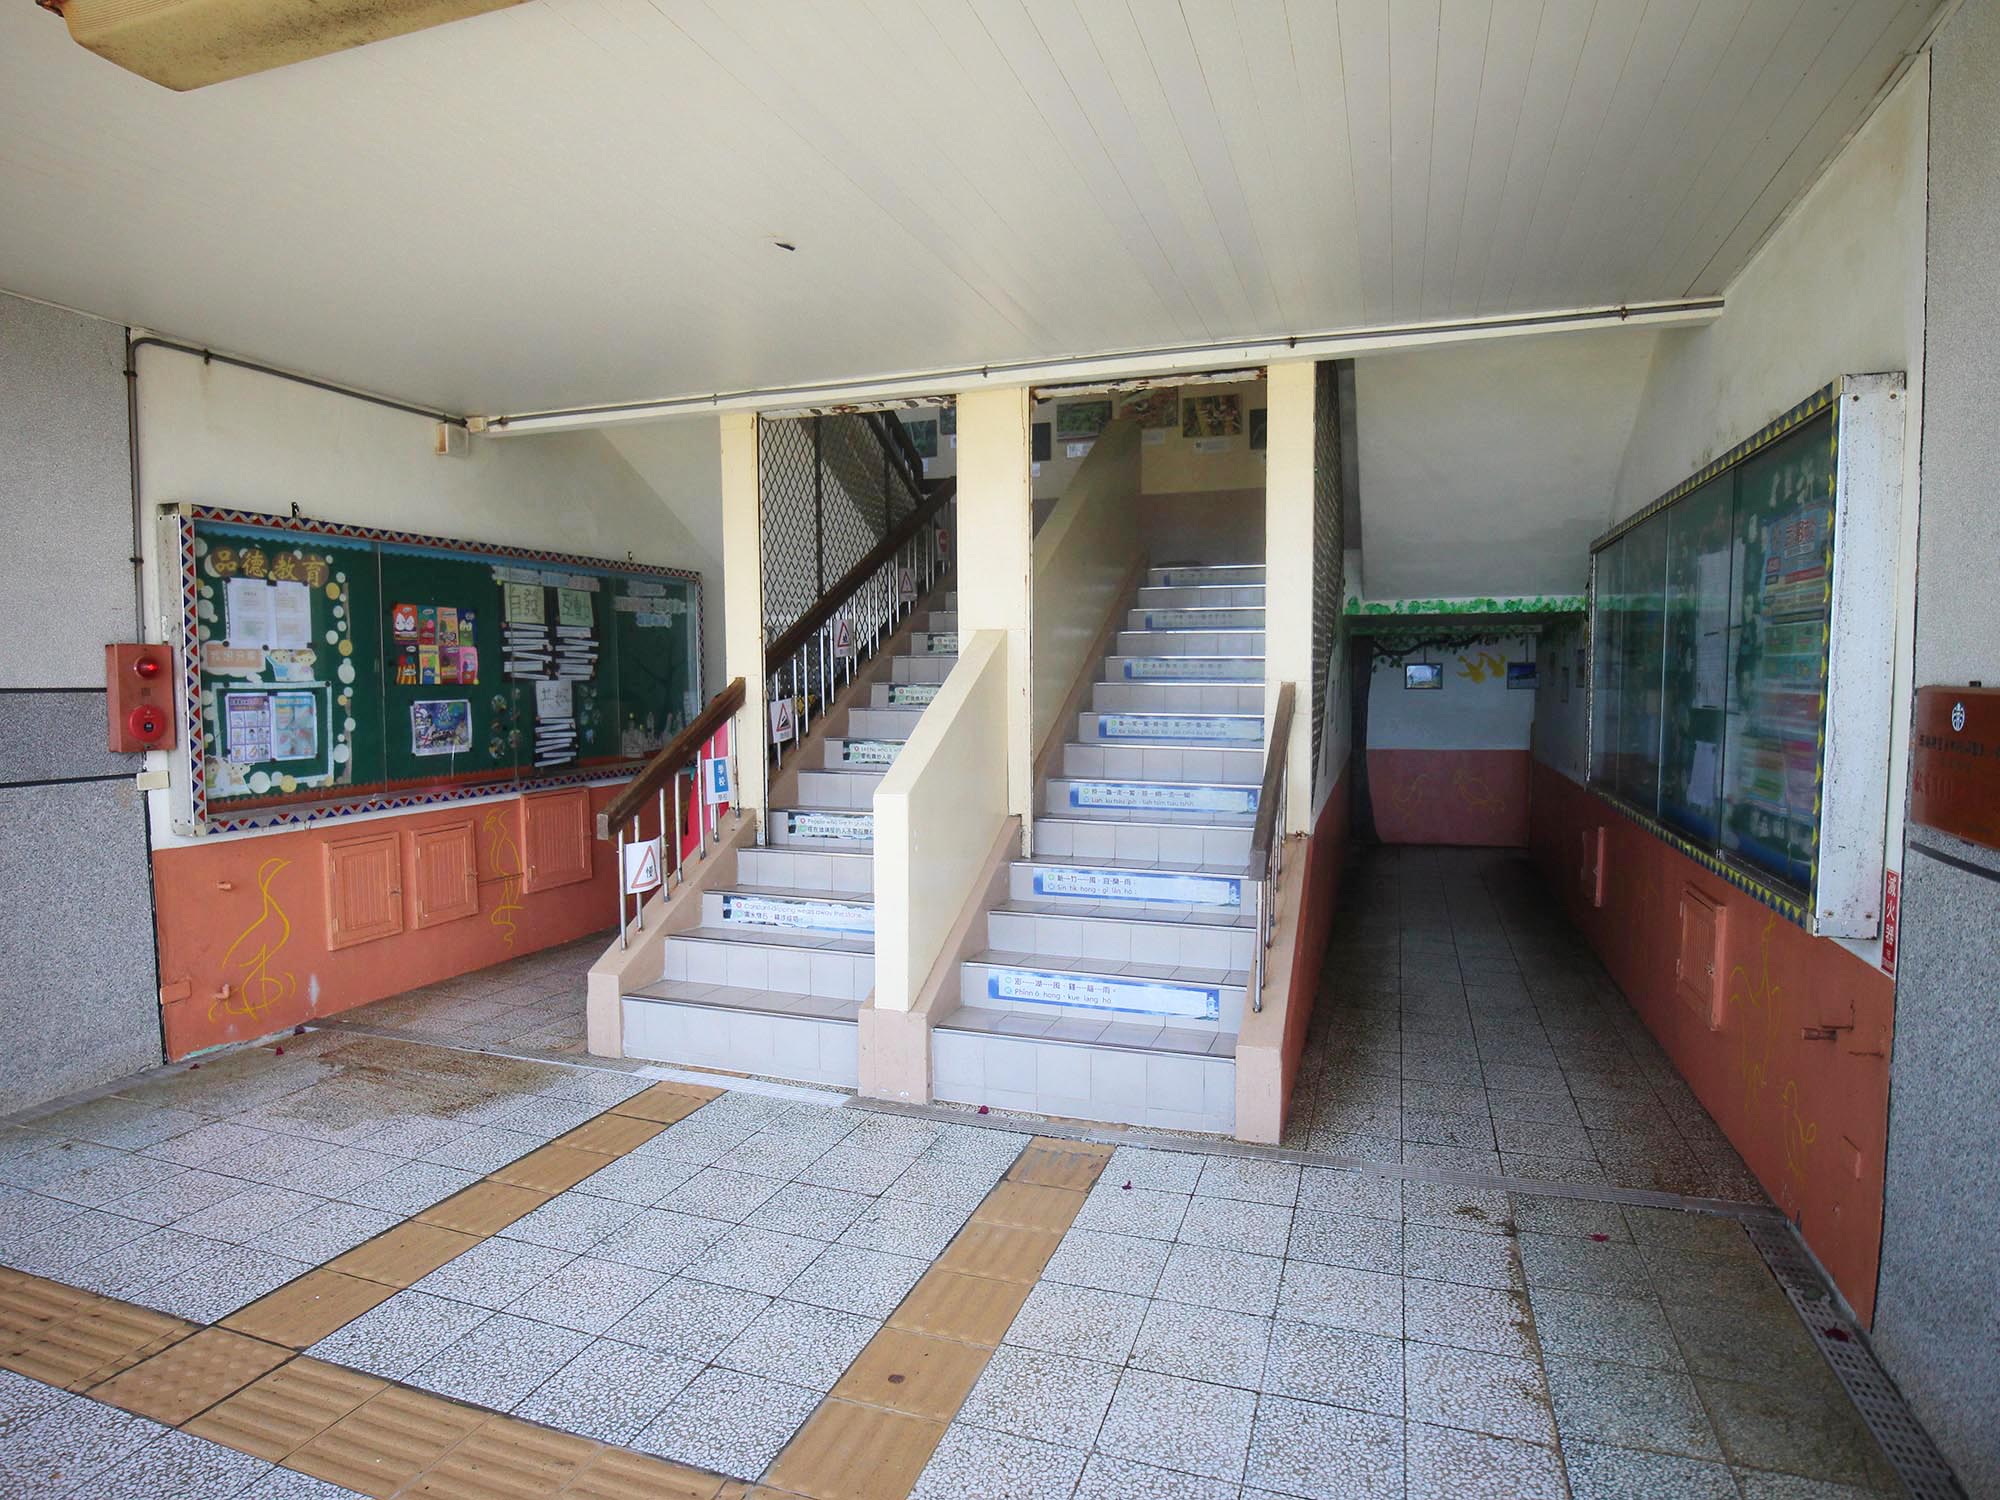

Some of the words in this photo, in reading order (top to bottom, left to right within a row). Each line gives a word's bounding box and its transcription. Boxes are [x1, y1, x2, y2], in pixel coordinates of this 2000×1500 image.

[215, 549, 326, 588] 品德教育
[646, 865, 654, 879] 慢
[1885, 874, 1897, 946] 滅火器
[1067, 993, 1080, 1002] kue
